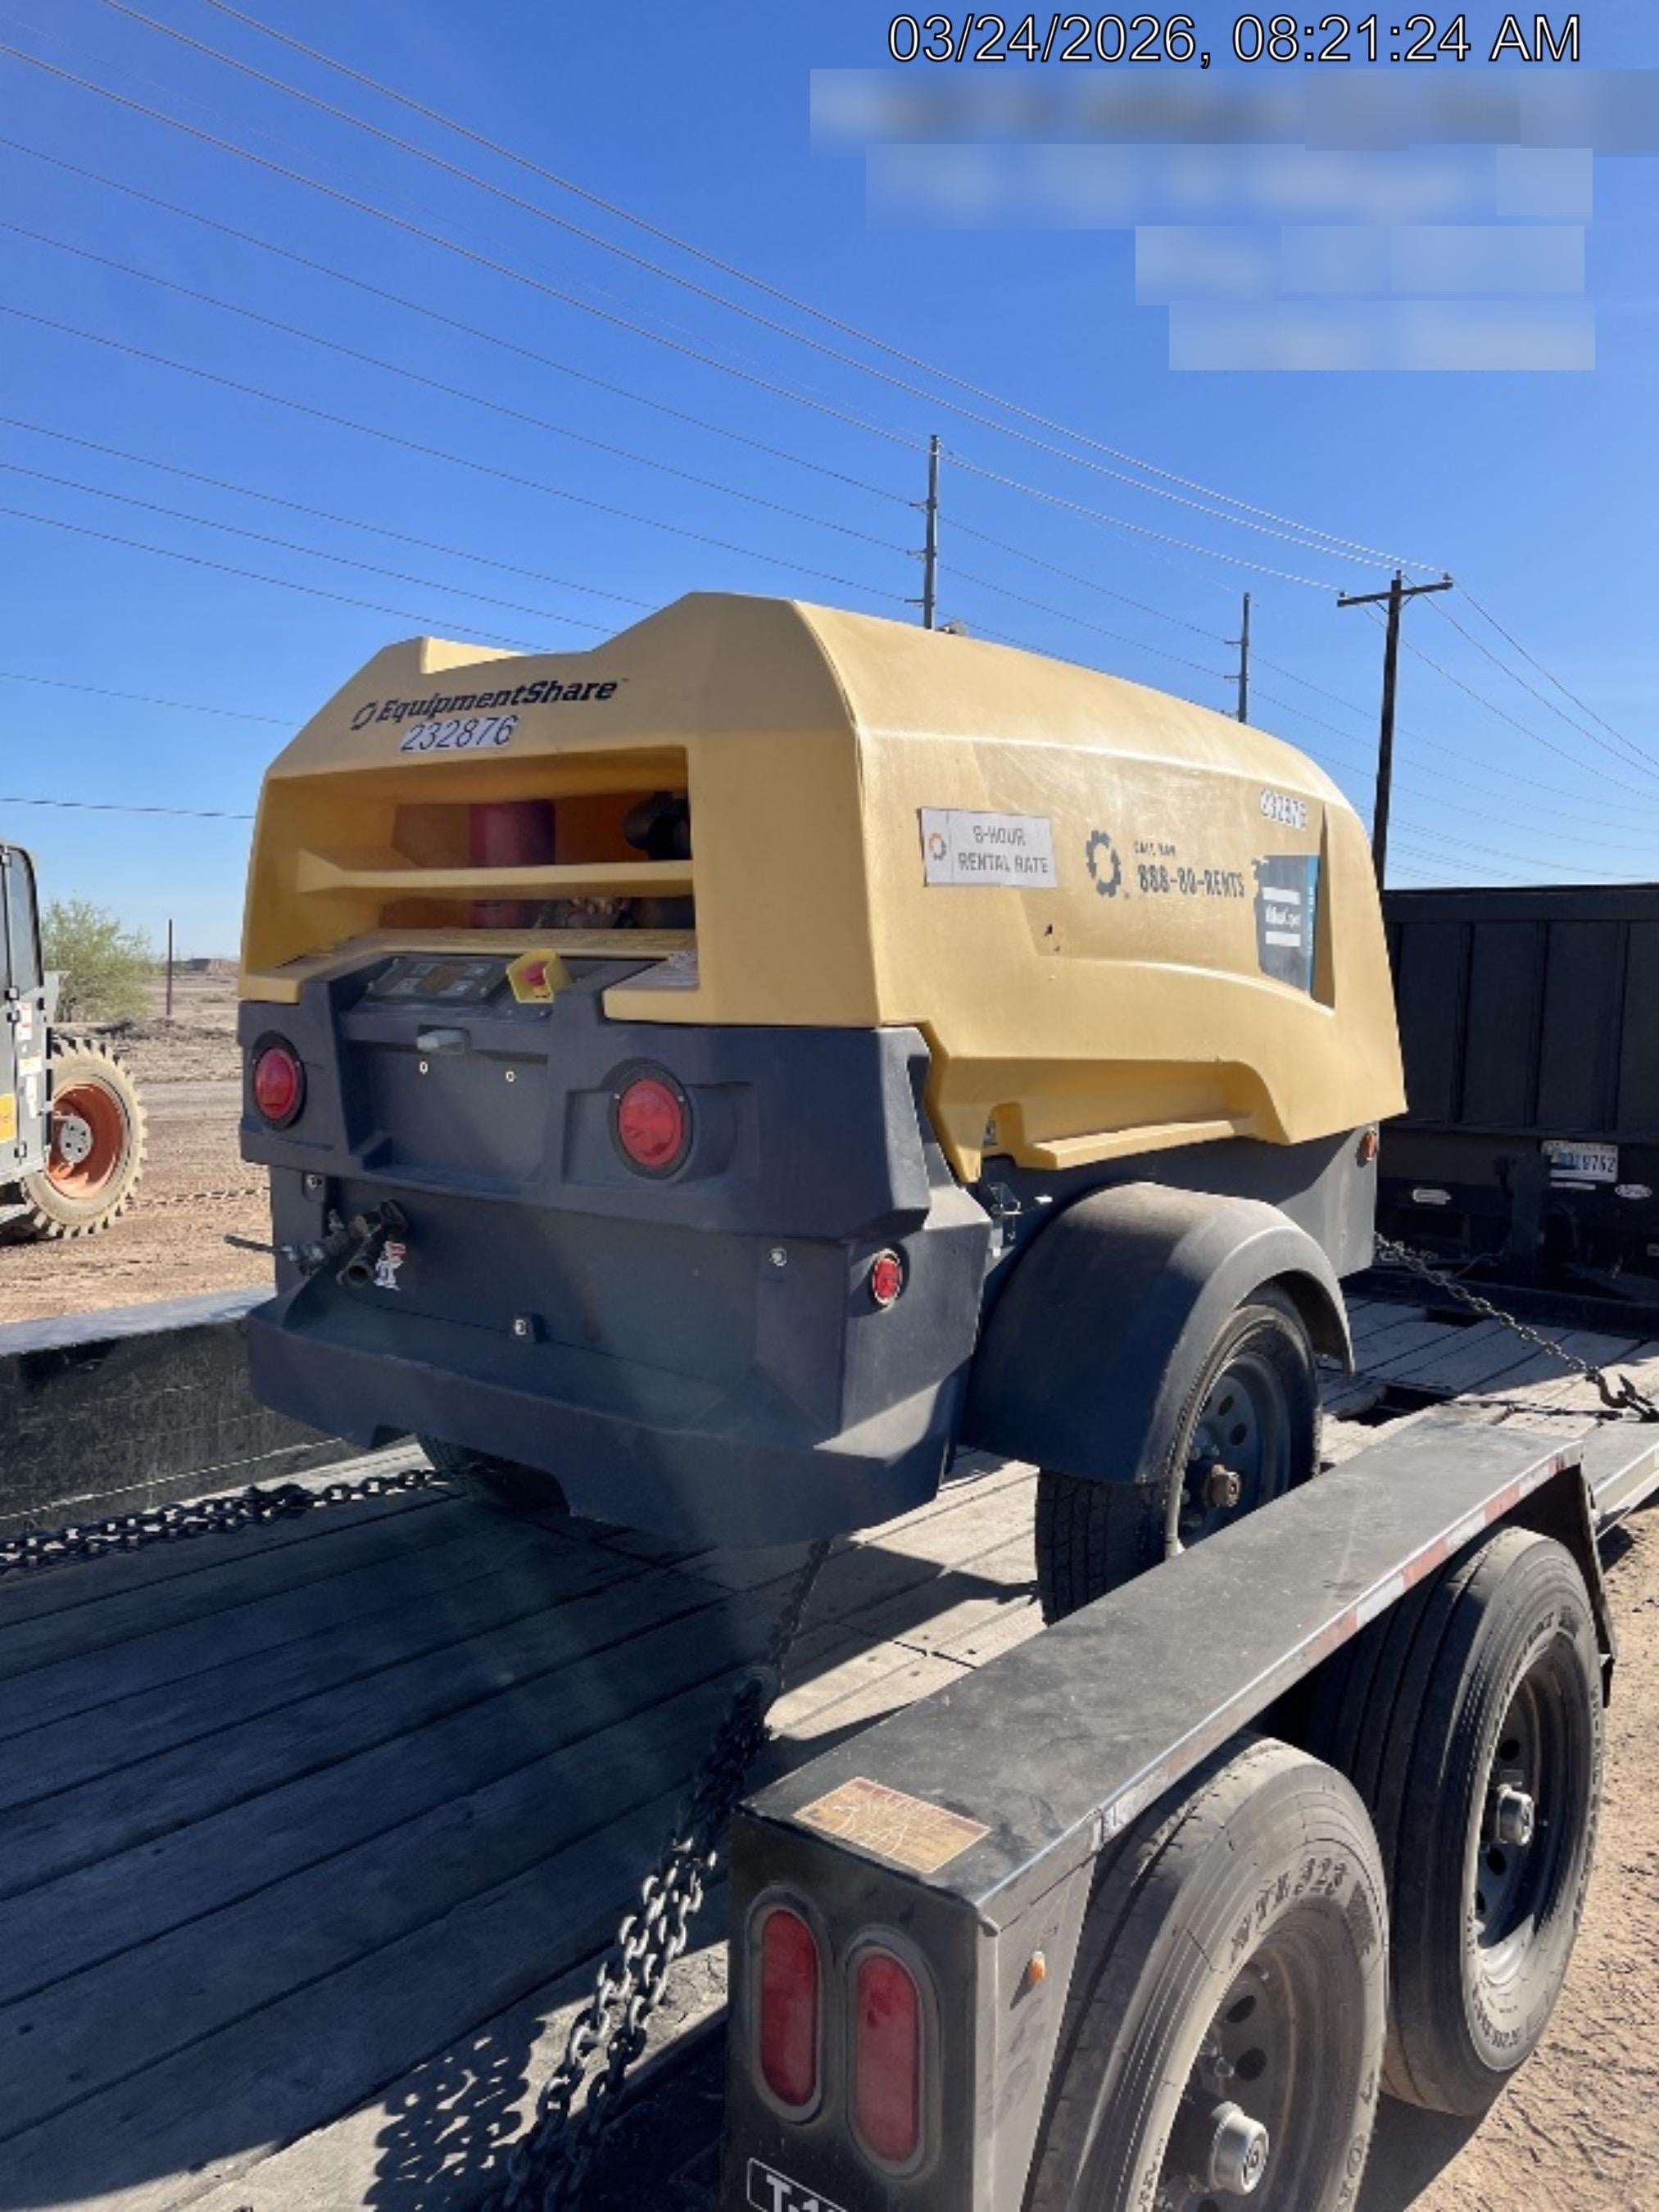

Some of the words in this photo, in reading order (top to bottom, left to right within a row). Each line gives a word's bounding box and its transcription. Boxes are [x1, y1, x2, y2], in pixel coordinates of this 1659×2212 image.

[376, 679, 618, 724] EquipmentShare
[401, 714, 519, 752] 232876
[958, 852, 1012, 873] RENTAL
[1014, 854, 1049, 874] RATE
[1137, 863, 1245, 898] 888-80-RENTS
